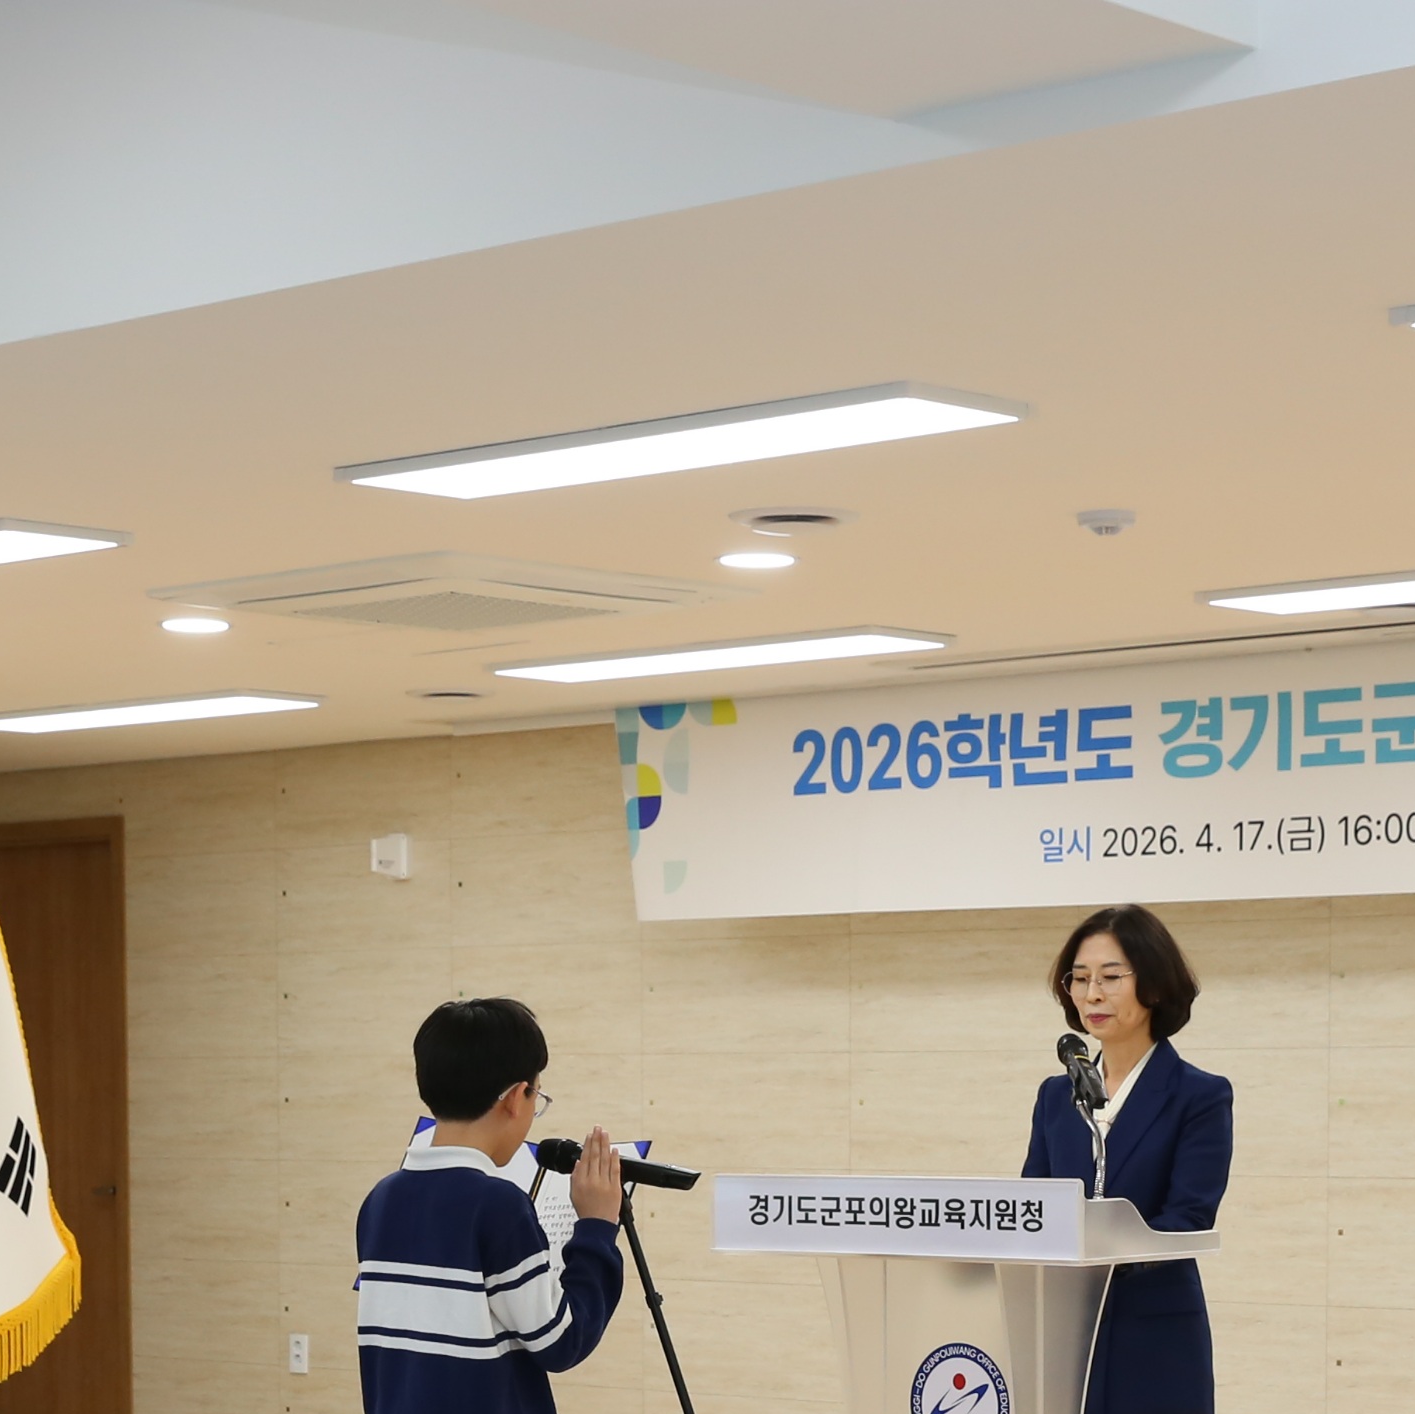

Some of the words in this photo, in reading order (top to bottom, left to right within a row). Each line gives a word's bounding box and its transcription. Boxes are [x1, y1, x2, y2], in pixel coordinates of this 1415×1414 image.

[791, 704, 1135, 797] 2026학년도
[1039, 826, 1092, 864] 일시
[1102, 824, 1186, 859] 2026.
[1195, 822, 1224, 855] 4.
[1234, 815, 1327, 856] 17.(금)
[748, 1194, 1045, 1234] 경기도군포의왕교육지원청
[922, 1345, 977, 1375] GUNPOUIWANG
[977, 1352, 1000, 1380] OFFICE
[995, 1378, 1006, 1393] OF
